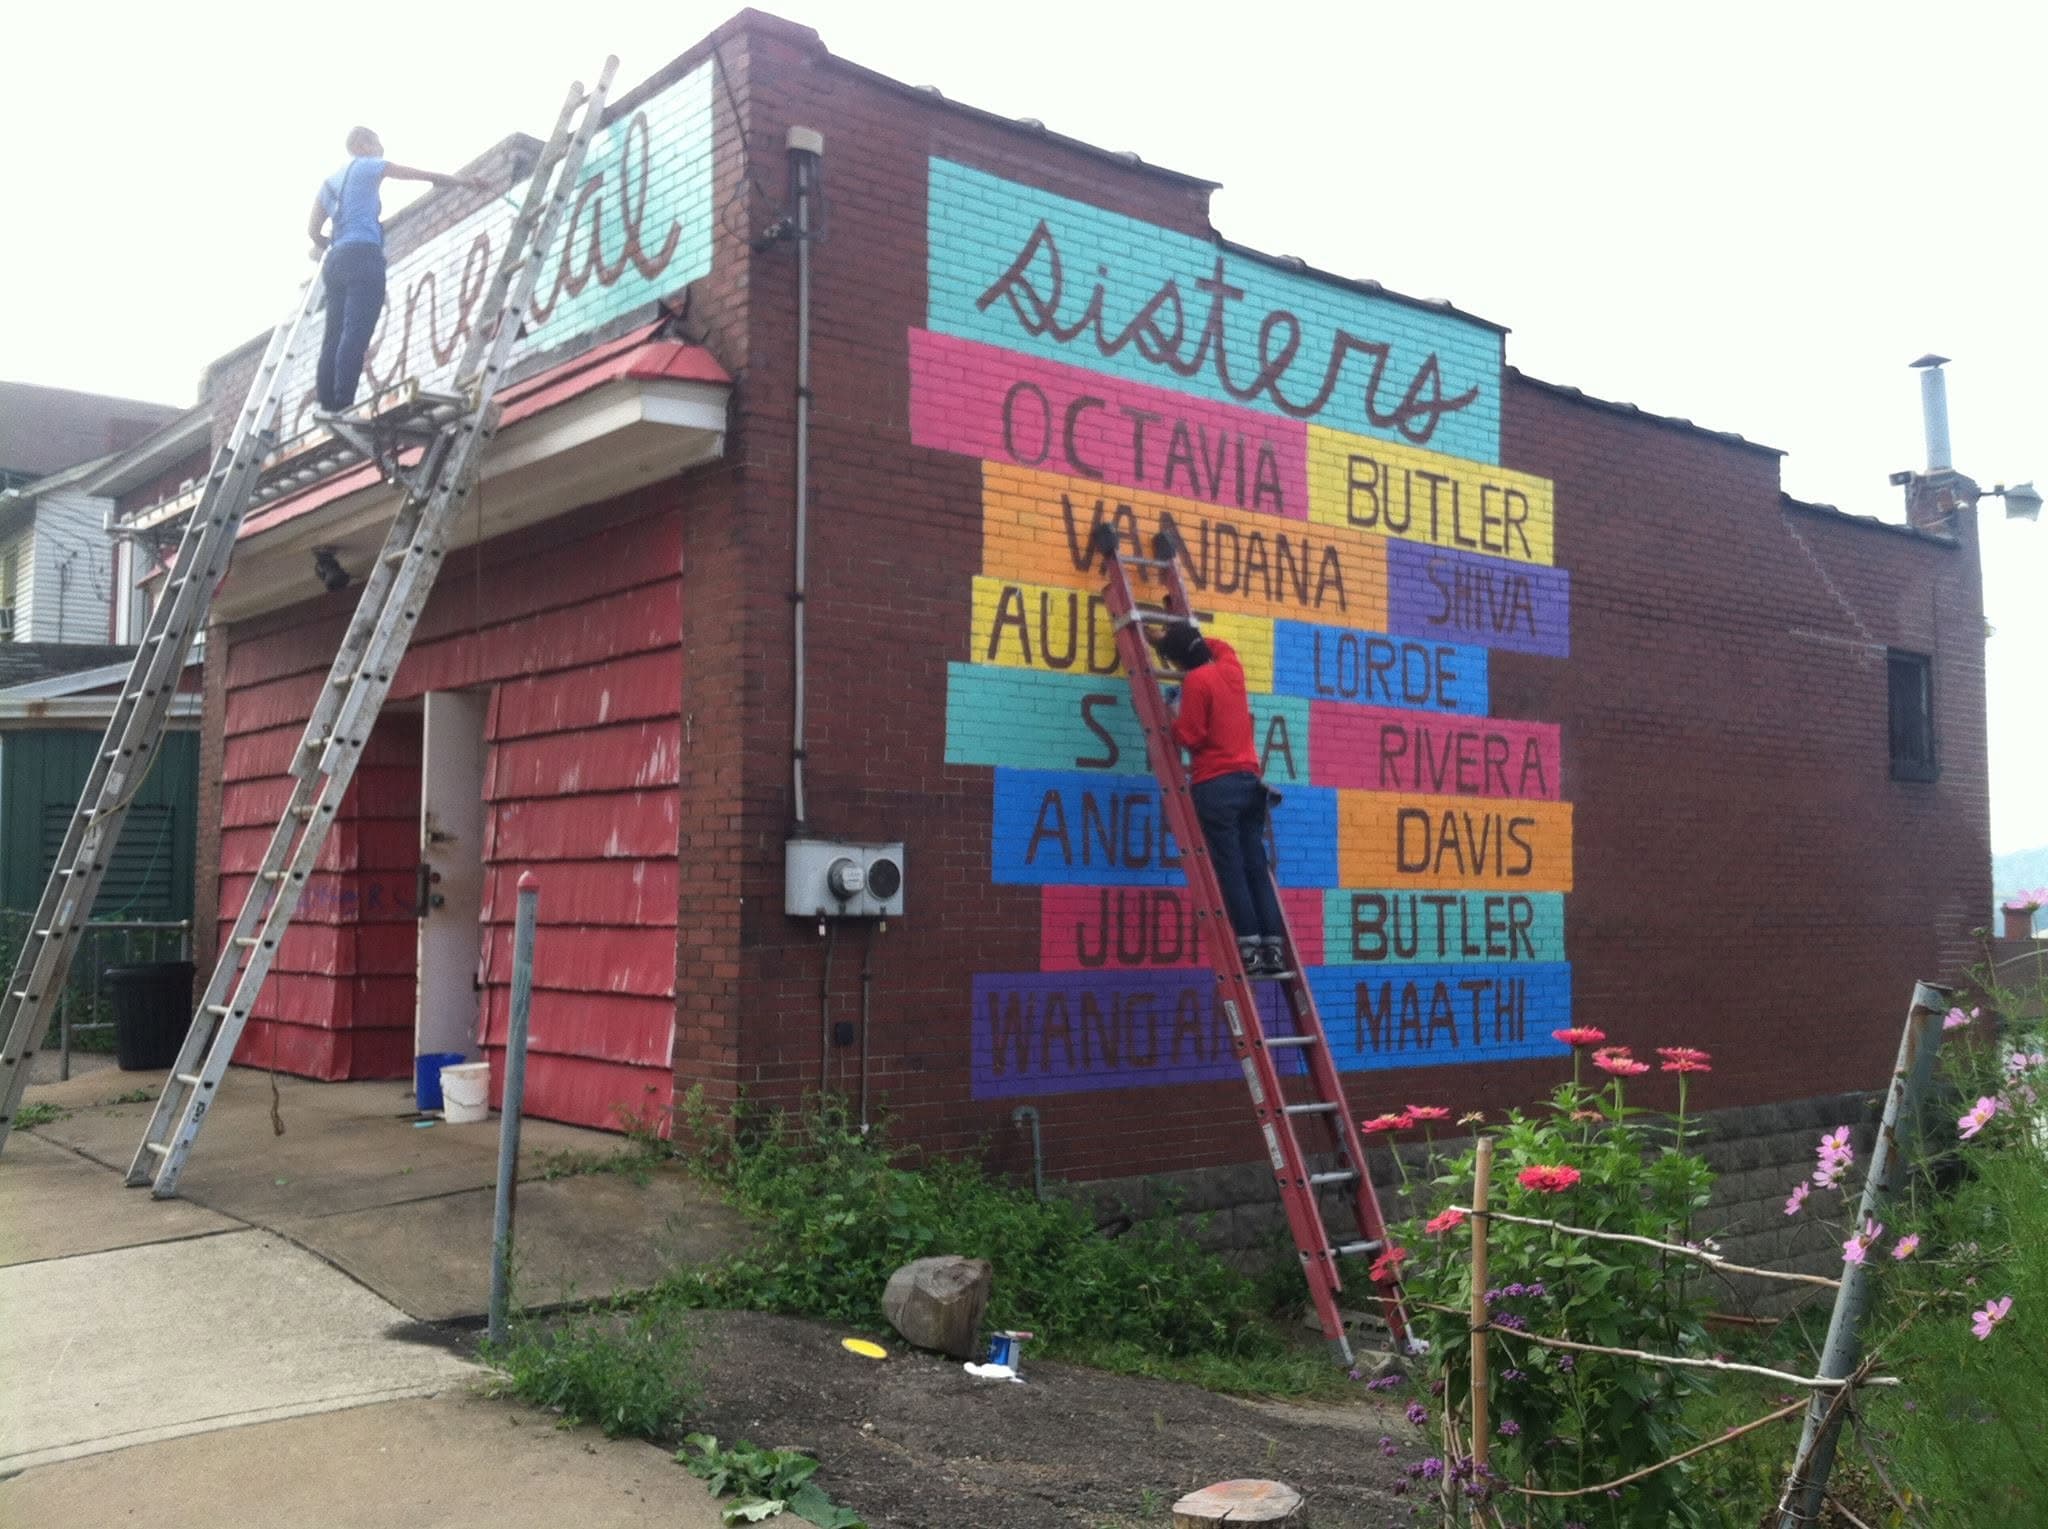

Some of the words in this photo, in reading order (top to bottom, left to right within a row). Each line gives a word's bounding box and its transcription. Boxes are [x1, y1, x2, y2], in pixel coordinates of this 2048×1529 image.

[975, 218, 1479, 444] sisters
[1001, 381, 1284, 513] OCTAVIA
[1345, 454, 1532, 559] BUTLER
[1060, 494, 1346, 612] VANDANA
[1426, 557, 1537, 637] SHIVA
[986, 585, 1214, 675] AUD
[1312, 631, 1459, 709] LORDE
[1379, 724, 1547, 796] RIVERA
[1396, 808, 1535, 878] DAVIS
[1350, 894, 1535, 962] BUTLER
[1354, 979, 1525, 1053] MAATHI
